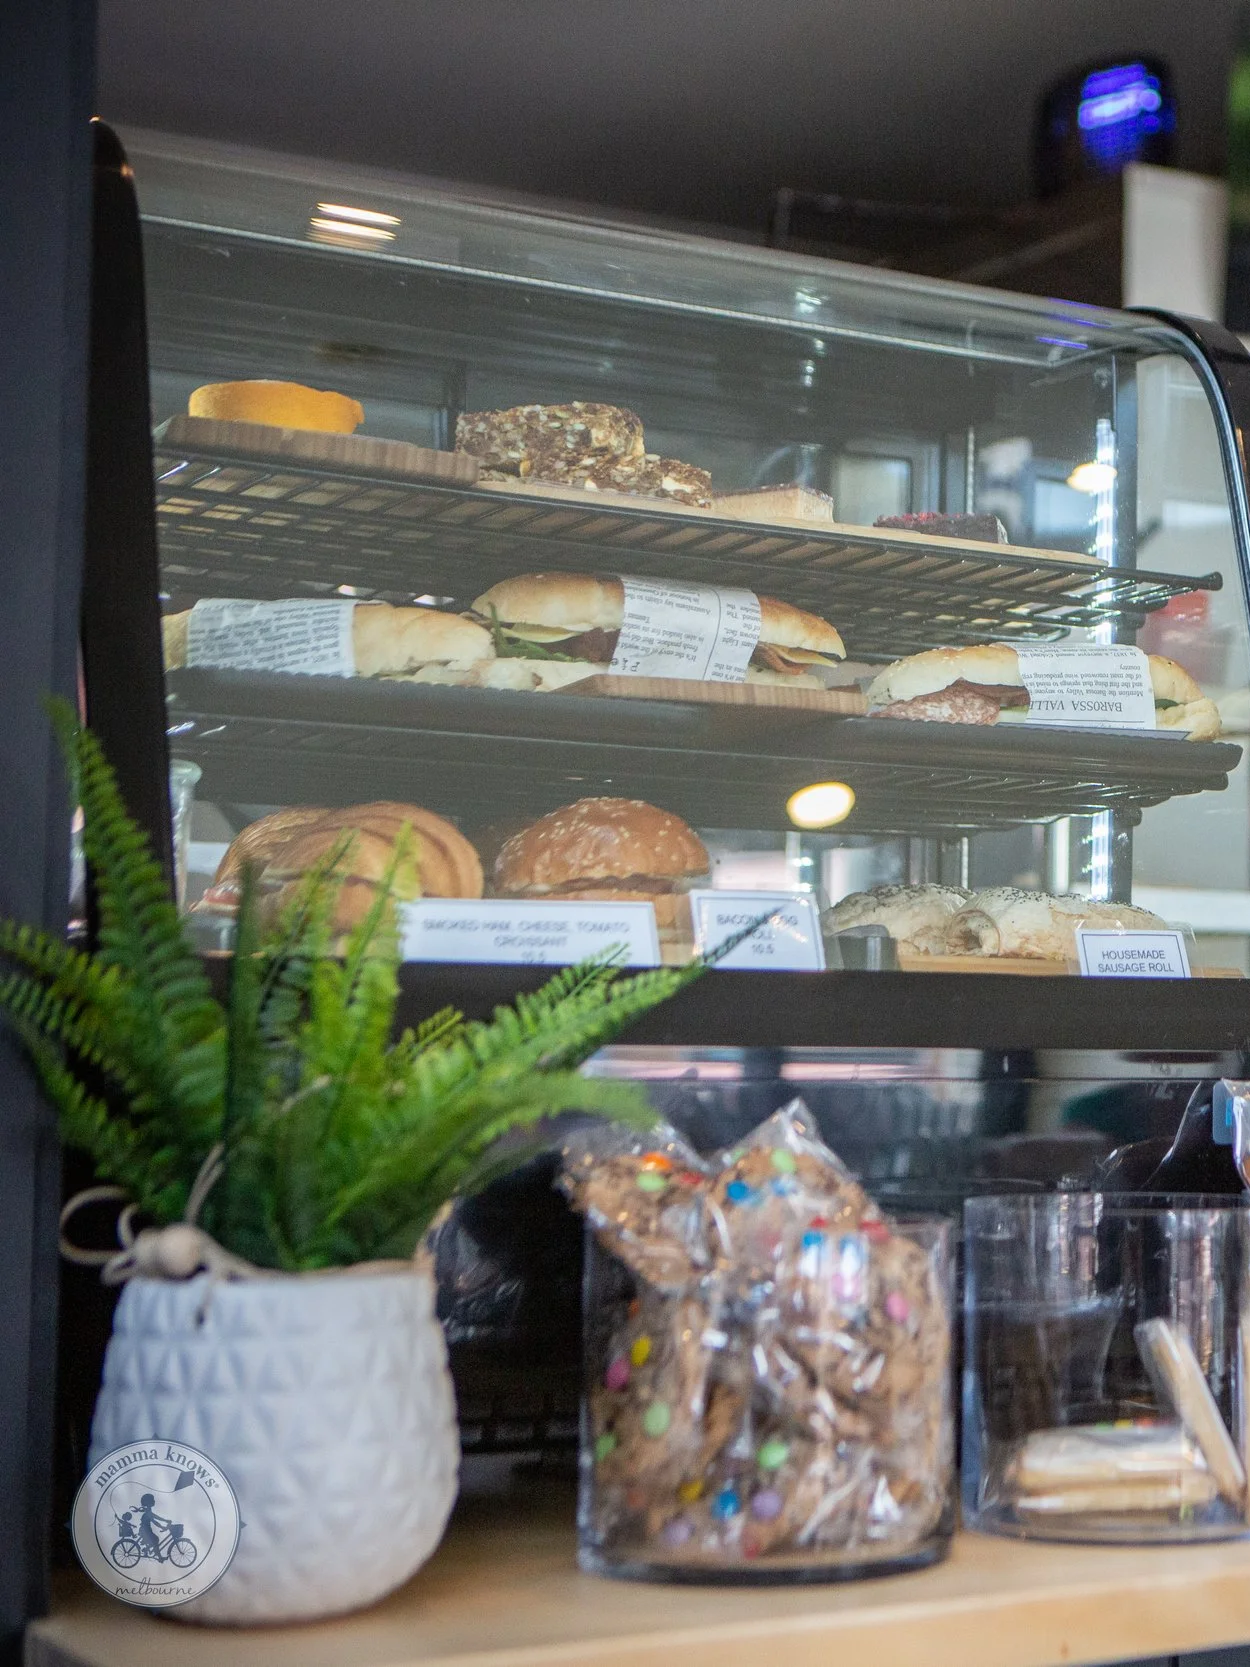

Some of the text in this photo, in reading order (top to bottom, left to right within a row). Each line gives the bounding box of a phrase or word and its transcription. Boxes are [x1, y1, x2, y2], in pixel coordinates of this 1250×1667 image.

[1033, 672, 1064, 680] producing
[1072, 701, 1122, 712] BAROSSA
[422, 918, 479, 932] SMOKED
[576, 921, 630, 933] TOMATO
[494, 935, 568, 948] CROISSANT
[1102, 950, 1166, 960] HOUSEMADE
[1098, 963, 1174, 973] SAUSAGE ROLL
